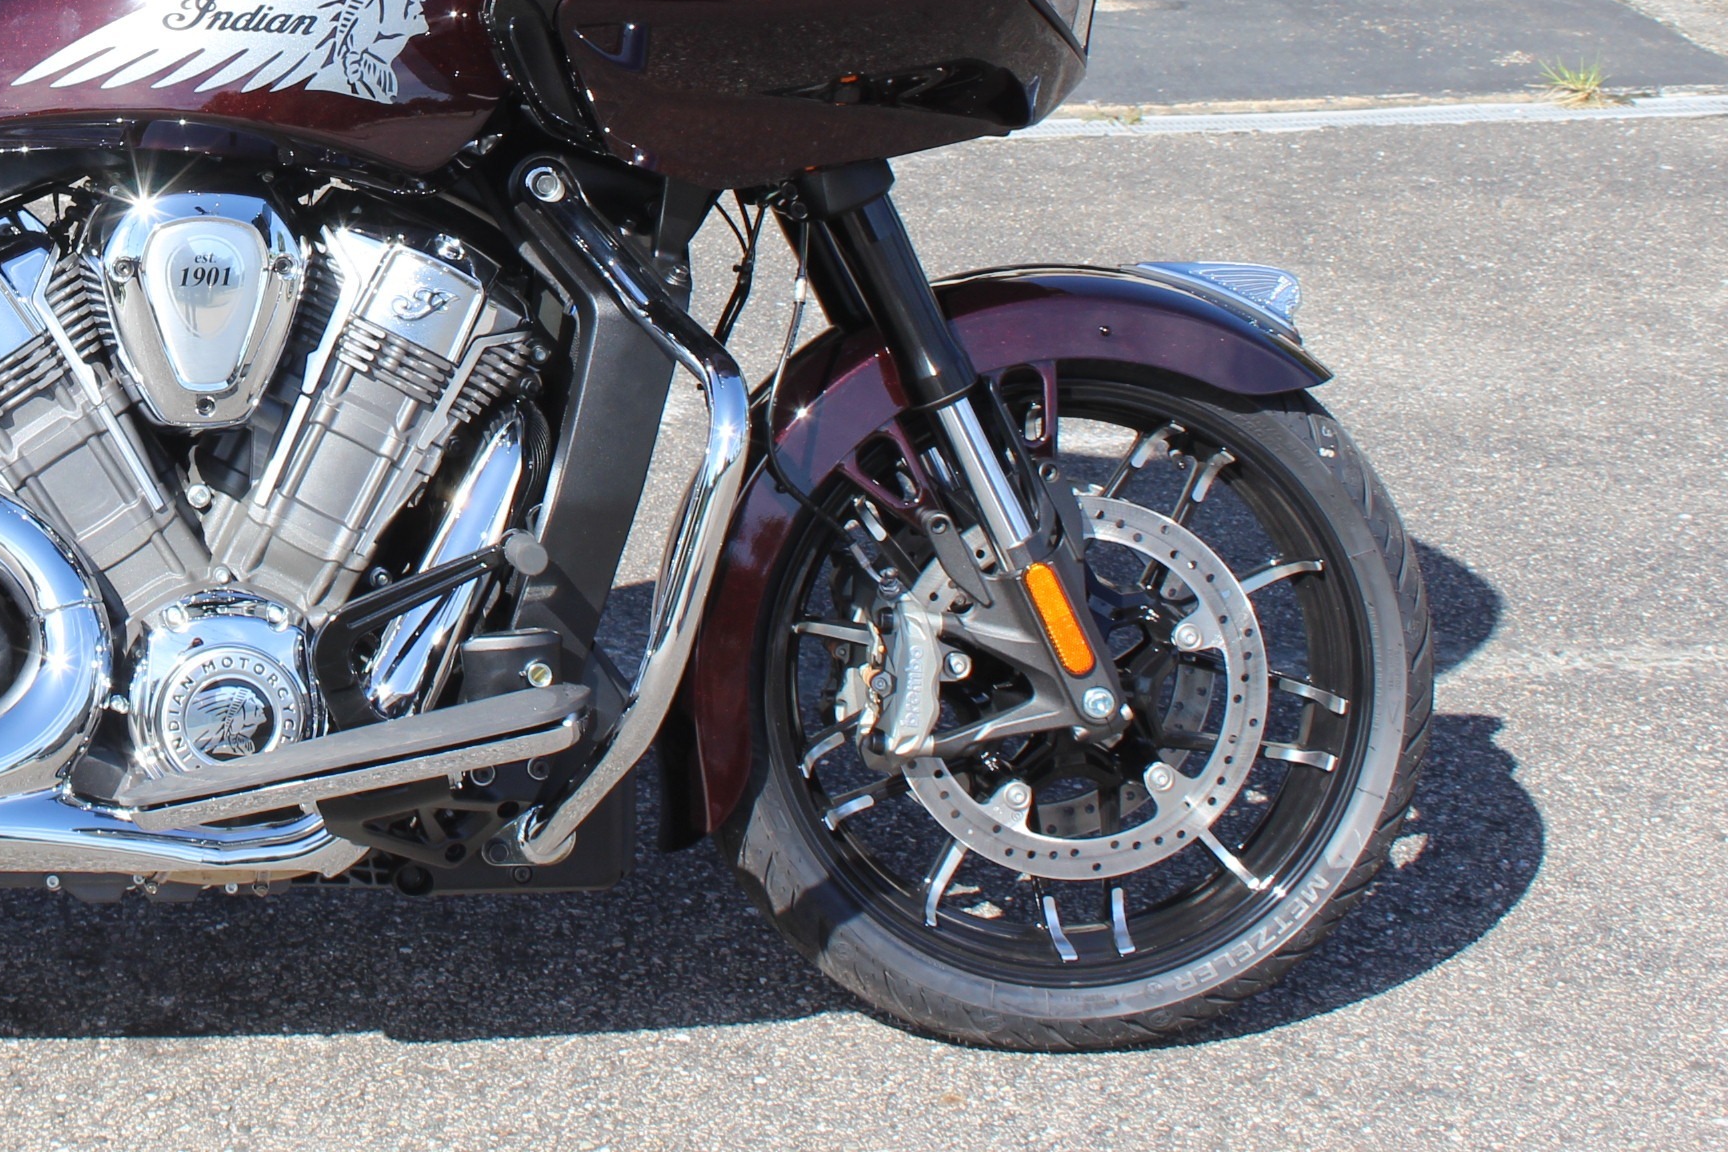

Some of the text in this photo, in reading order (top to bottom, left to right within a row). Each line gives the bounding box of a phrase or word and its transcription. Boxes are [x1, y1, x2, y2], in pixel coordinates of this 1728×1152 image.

[179, 266, 232, 288] 1901
[194, 253, 216, 265] est.
[167, 676, 196, 763] INDIAN
[899, 644, 923, 728] brembo
[1175, 872, 1330, 992] METZELER
